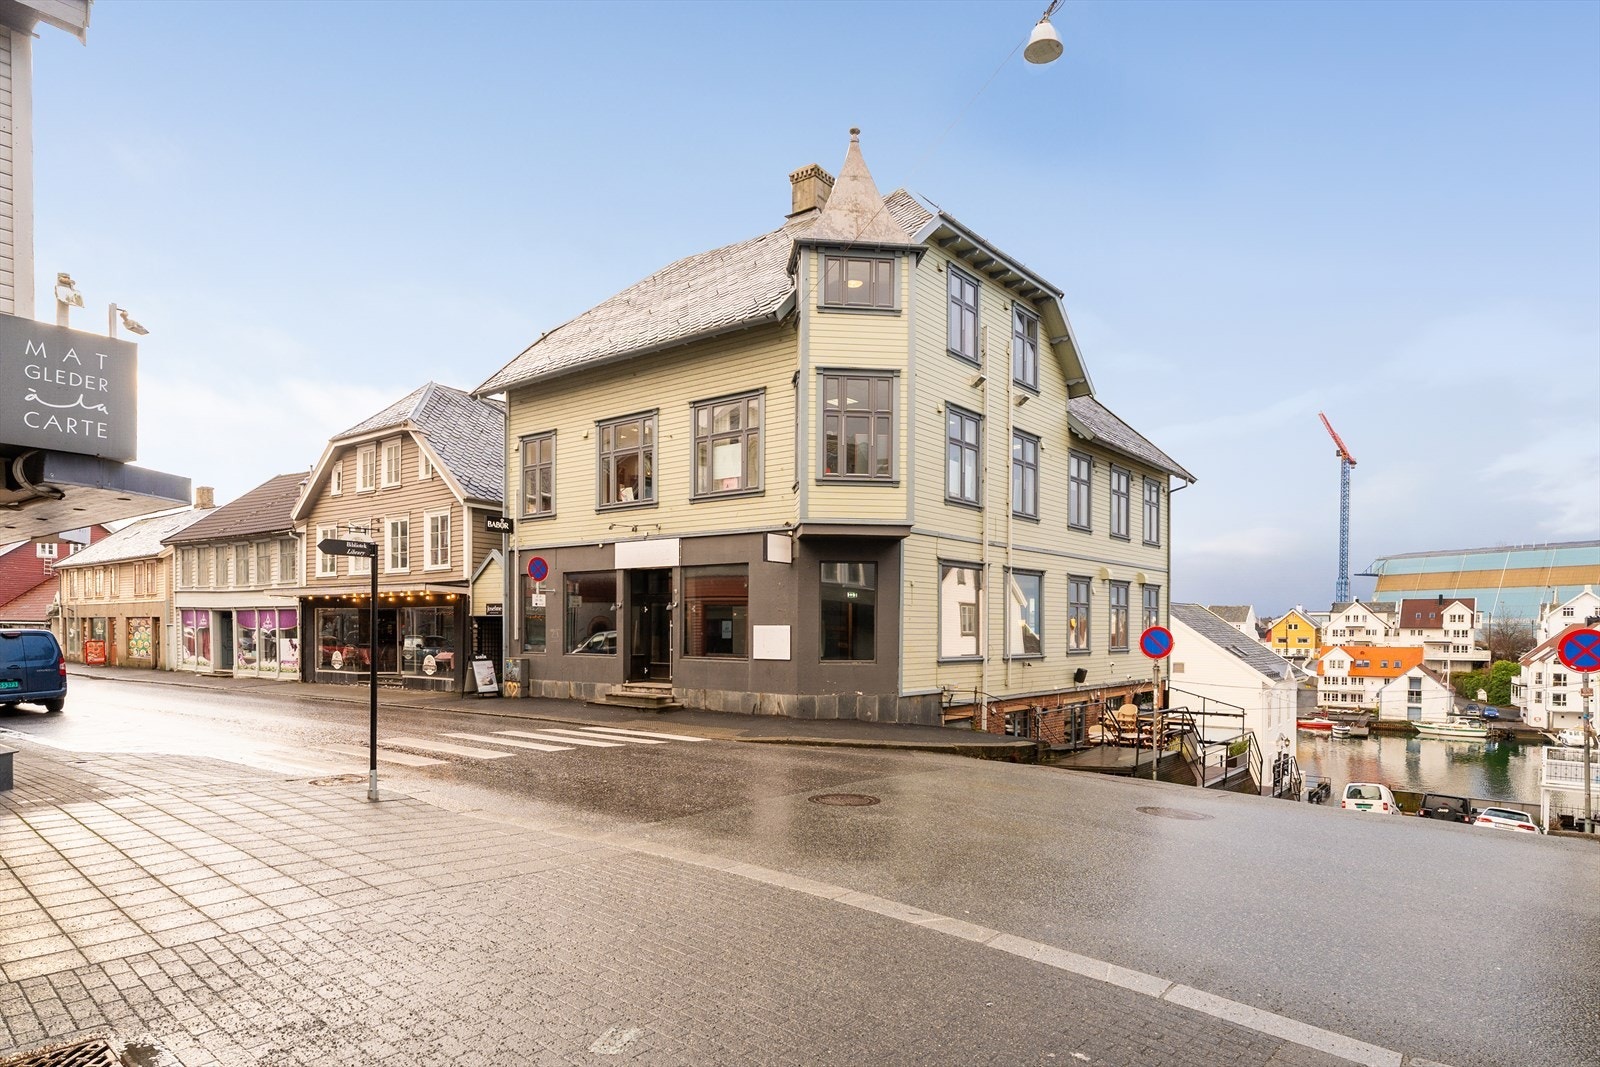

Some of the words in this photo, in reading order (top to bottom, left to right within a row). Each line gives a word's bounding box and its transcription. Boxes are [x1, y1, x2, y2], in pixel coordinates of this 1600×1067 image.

[24, 339, 108, 369] MAT
[24, 364, 109, 393] GLEDER
[23, 411, 108, 439] CARTE
[346, 541, 367, 549] Bibliotek
[346, 548, 366, 557] Library
